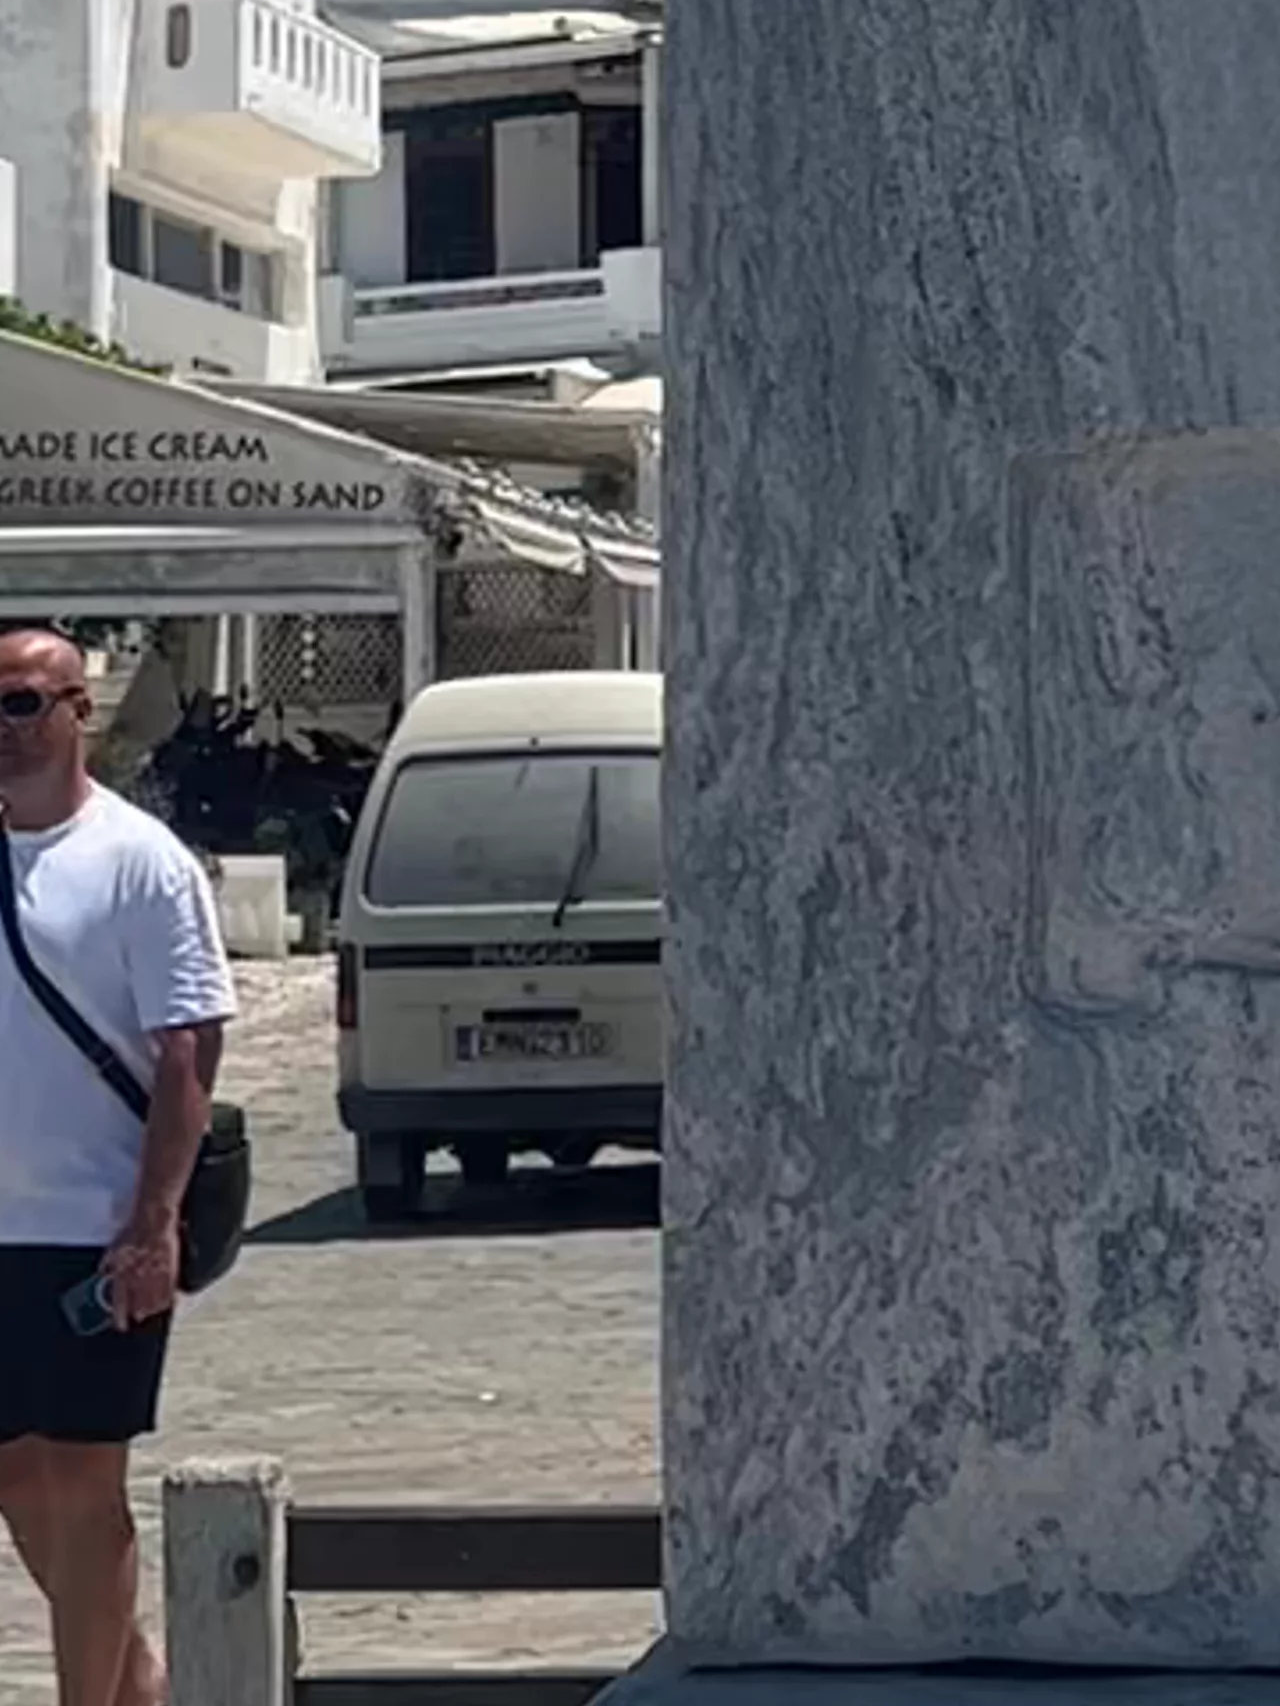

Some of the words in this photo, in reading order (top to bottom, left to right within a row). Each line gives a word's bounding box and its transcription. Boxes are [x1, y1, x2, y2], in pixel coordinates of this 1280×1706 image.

[90, 431, 138, 462] ICE
[148, 431, 268, 463] CREAM
[104, 476, 218, 508] COFFEE
[226, 478, 281, 509] ON
[293, 480, 385, 511] SAND
